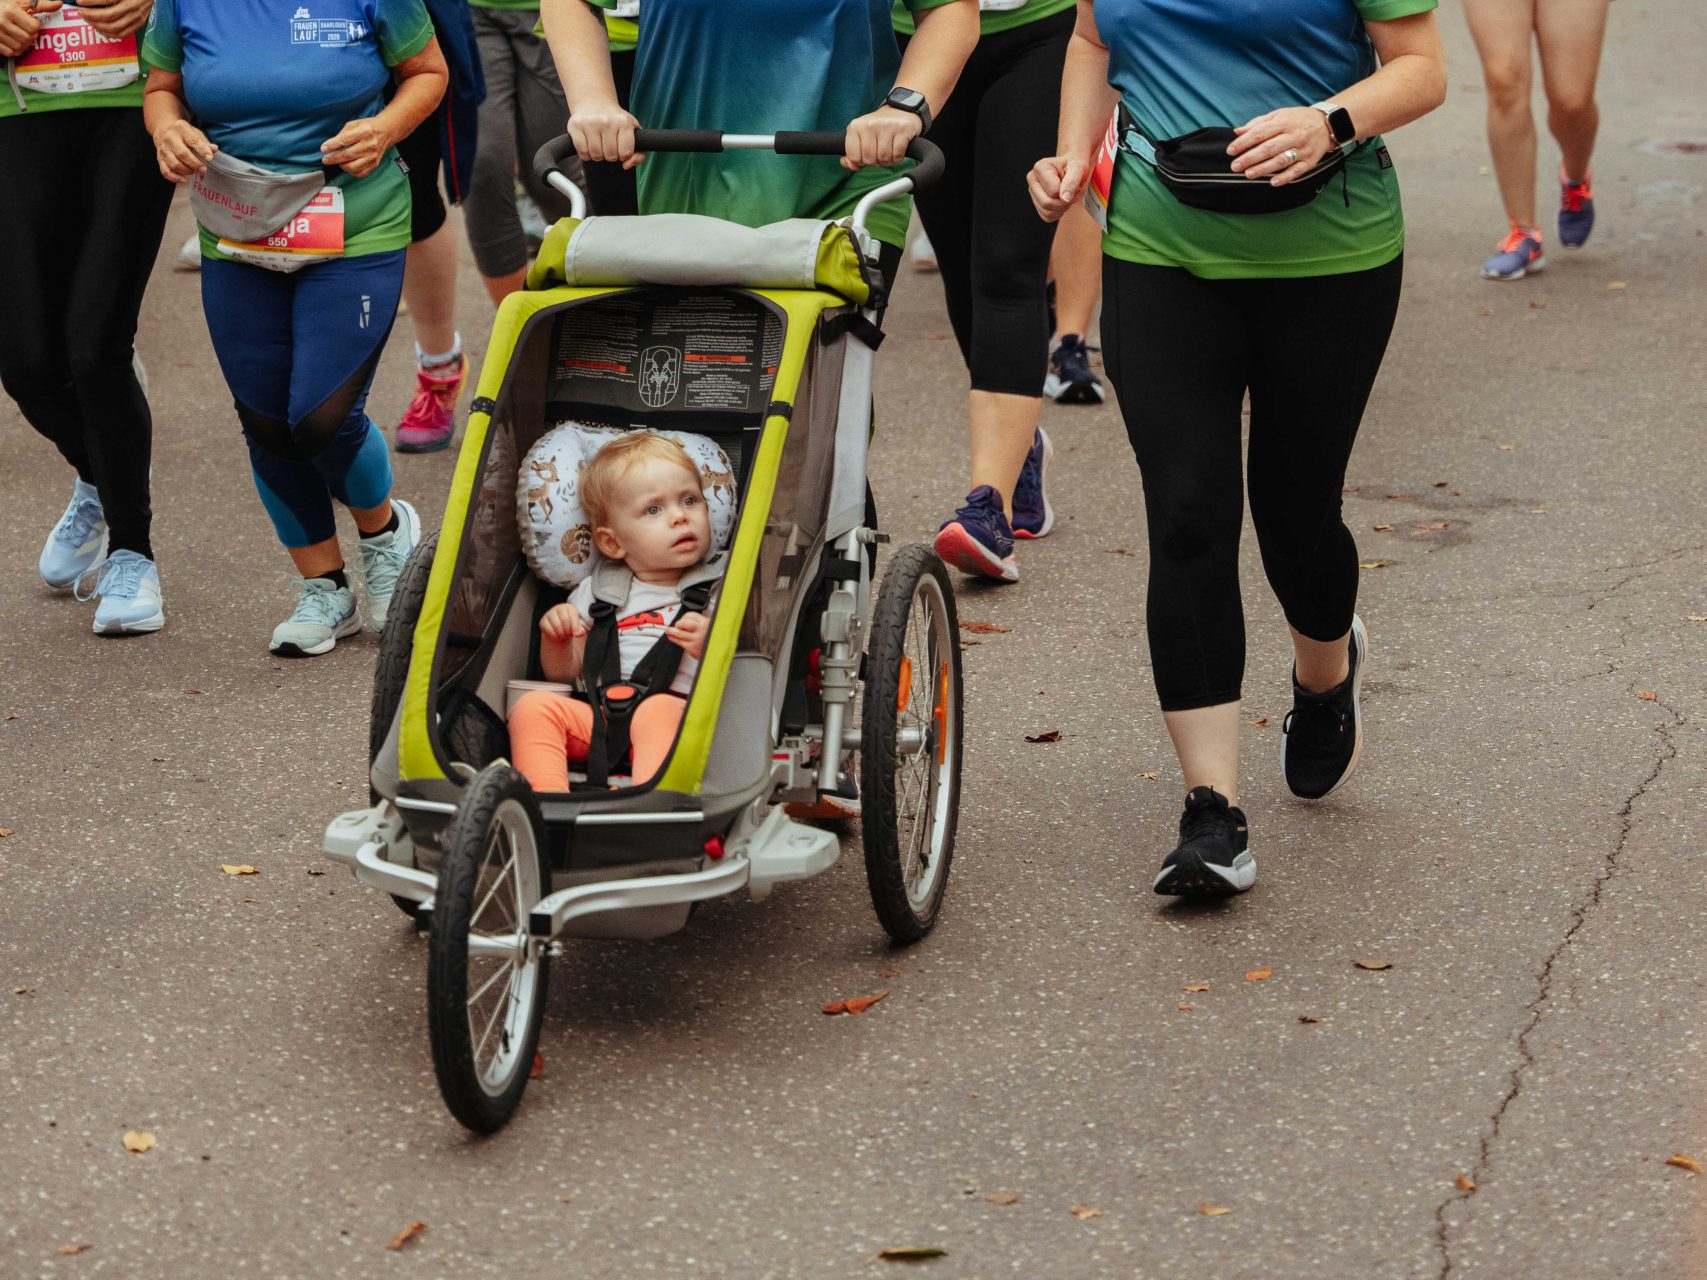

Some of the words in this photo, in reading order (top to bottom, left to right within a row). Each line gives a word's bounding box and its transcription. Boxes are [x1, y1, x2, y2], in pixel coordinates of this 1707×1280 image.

[293, 21, 318, 31] FRAUEN
[293, 30, 318, 41] LAUF
[60, 51, 86, 63] 1300
[193, 181, 258, 217] FRAUENLAUF
[268, 237, 288, 248] 550
